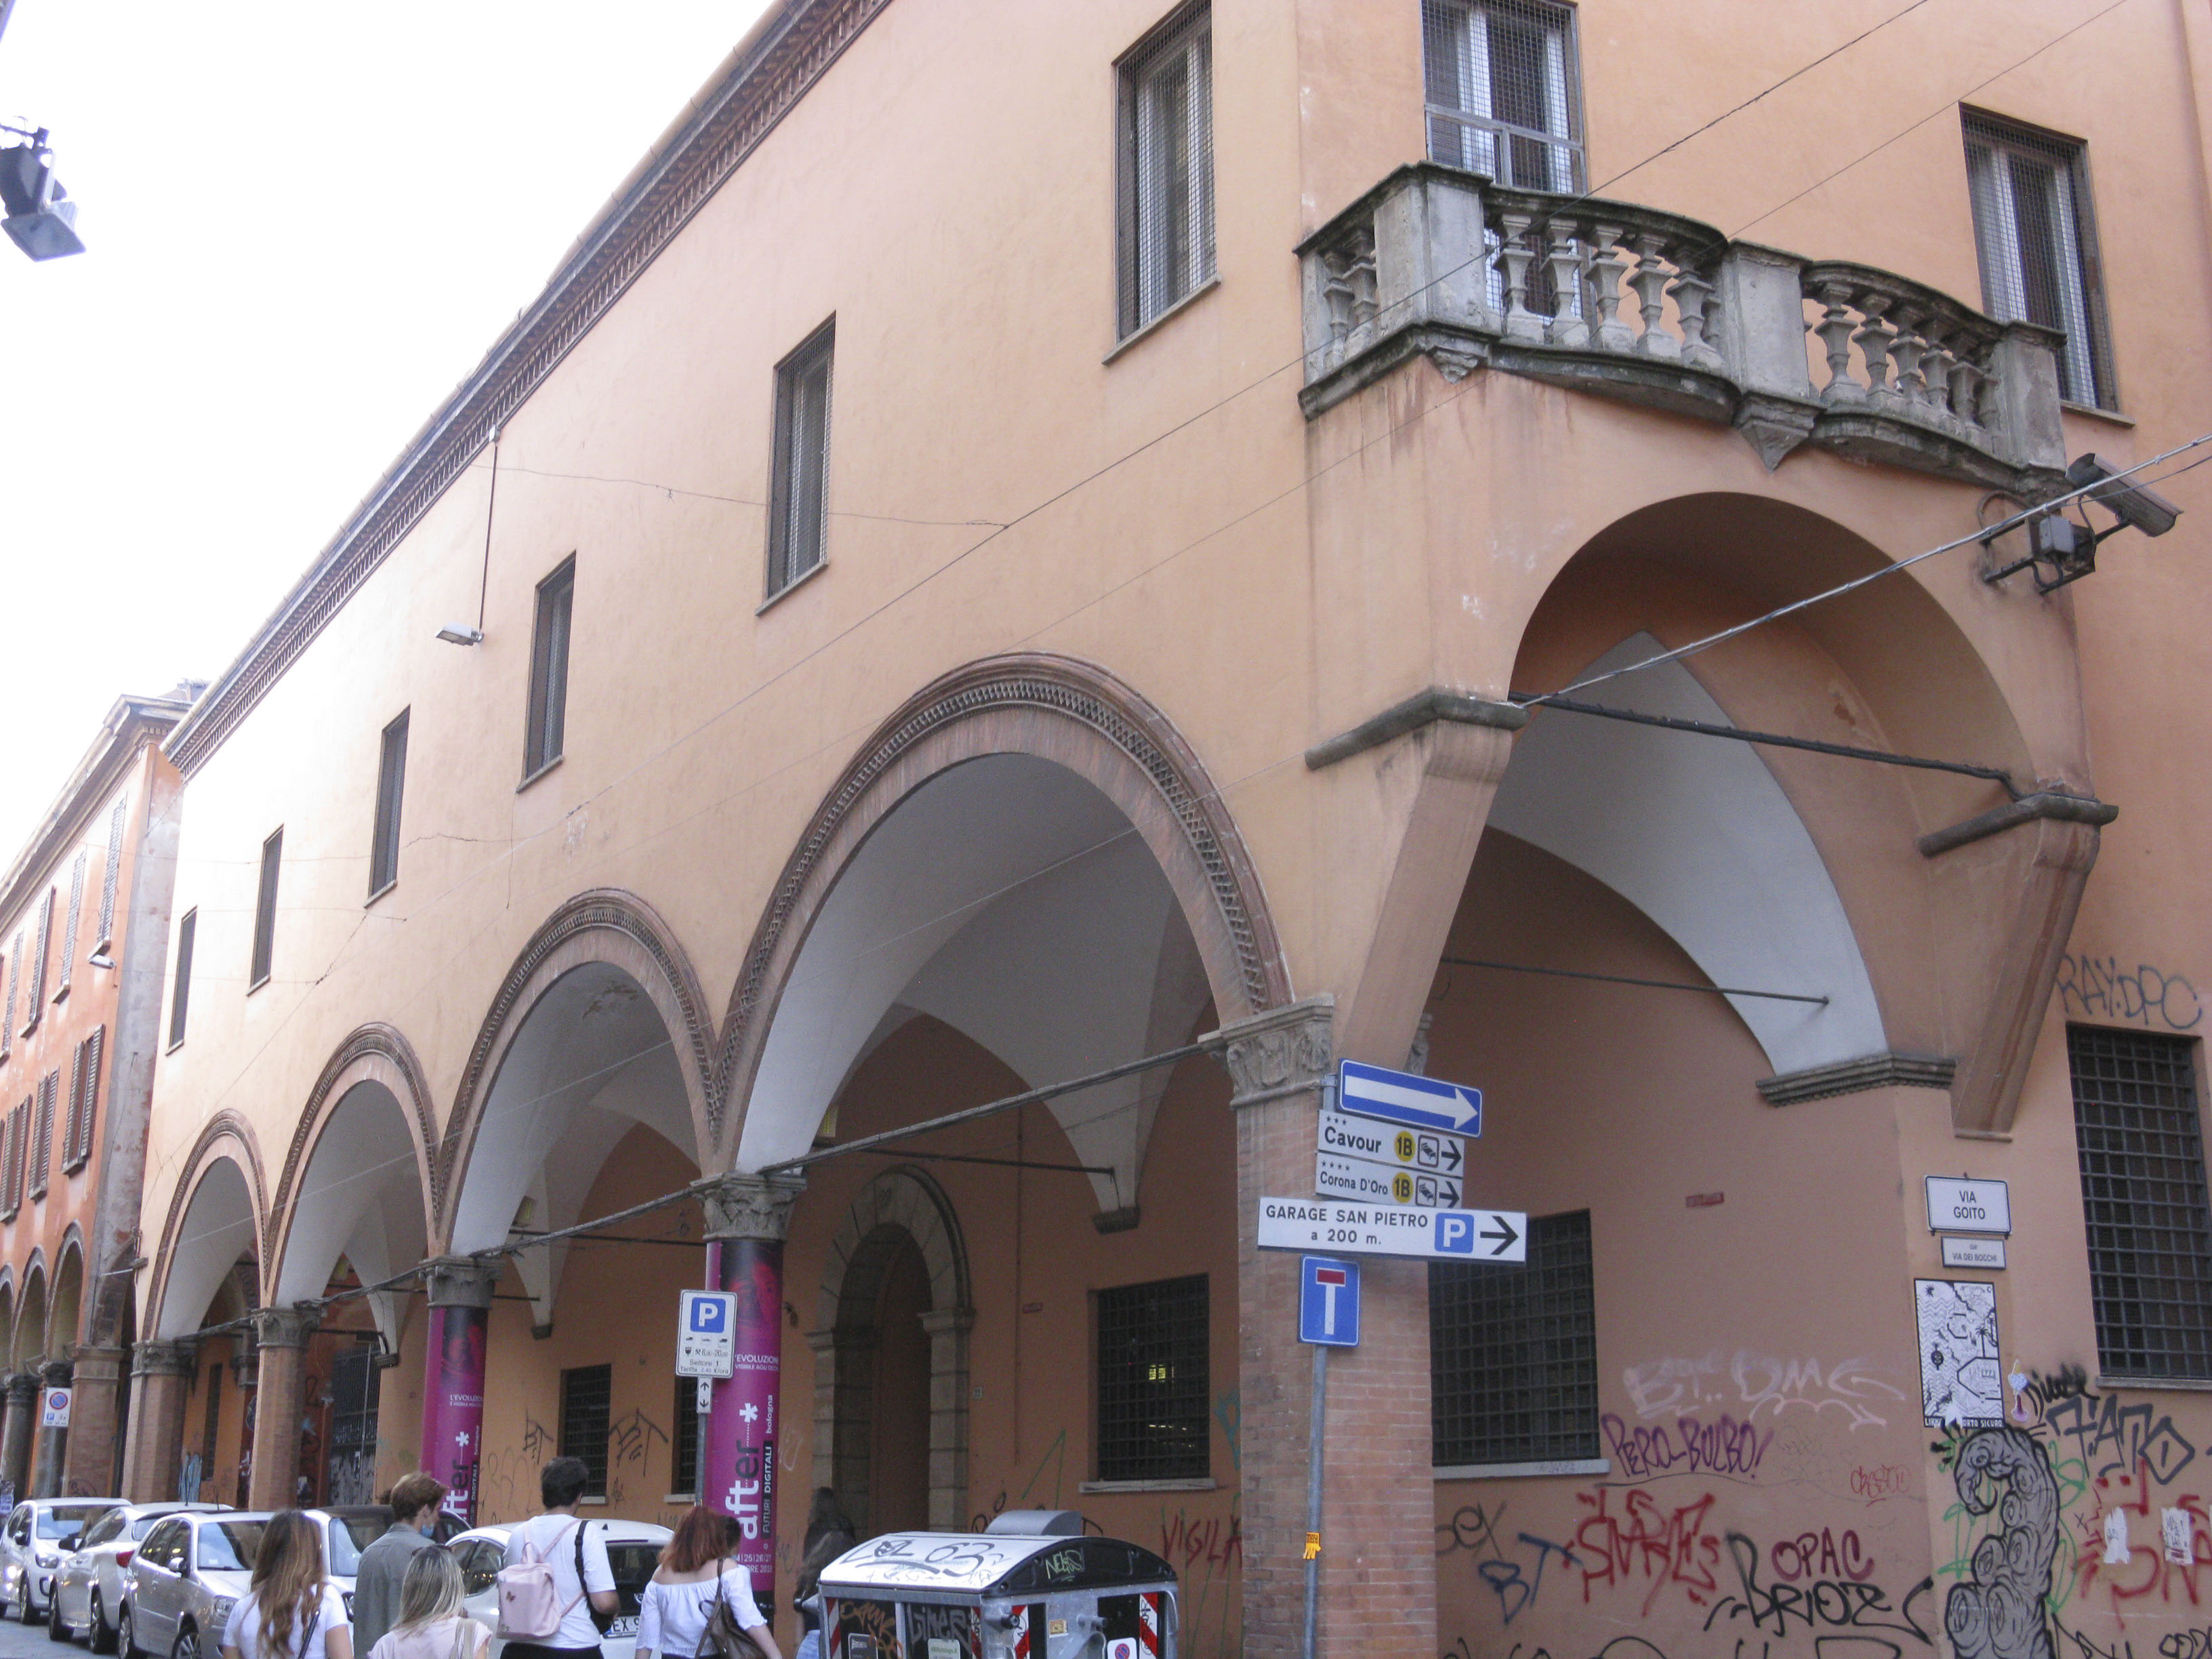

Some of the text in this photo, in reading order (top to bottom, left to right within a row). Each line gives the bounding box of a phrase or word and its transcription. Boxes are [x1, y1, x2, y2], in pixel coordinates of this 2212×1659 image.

[1324, 1126, 1413, 1157] Cavour 1B
[1320, 1171, 1410, 1198] Corona D'Oro 1B
[1959, 1190, 1977, 1203] VIA
[1266, 1205, 1428, 1227] GARAGE SAN PIETRO
[1953, 1206, 1986, 1220] GOITO
[1311, 1229, 1382, 1245] a 200 m.
[1443, 1218, 1467, 1248] P
[1952, 1252, 1997, 1263] VIA DEI BOCCHI
[698, 1302, 718, 1327] P
[689, 1359, 712, 1367] Settore
[765, 1395, 773, 1434] bologna
[1963, 1419, 1978, 1427] ORTO
[443, 1459, 469, 1515] fter
[724, 1439, 759, 1540] after
[762, 1446, 773, 1533] FUTURI DIGITALI
